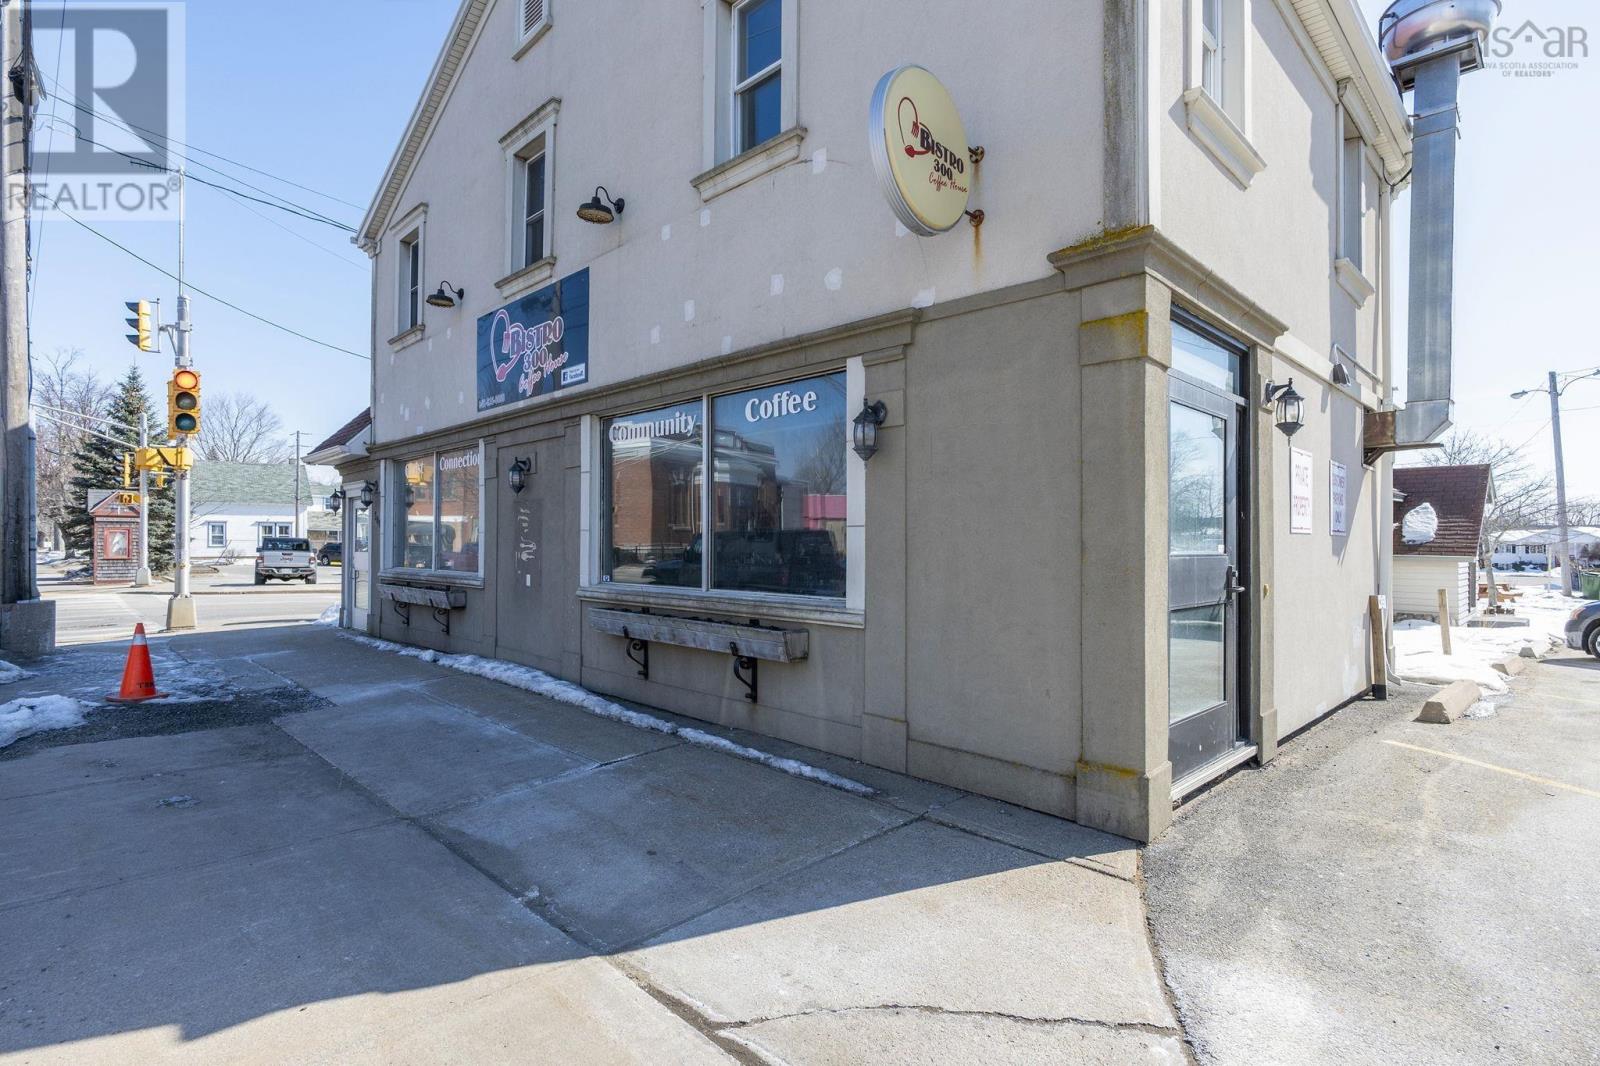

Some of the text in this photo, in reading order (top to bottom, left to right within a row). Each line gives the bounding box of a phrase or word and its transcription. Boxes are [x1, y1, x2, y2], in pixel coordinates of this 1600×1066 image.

[920, 123, 964, 174] BISTRO
[929, 171, 968, 193] Coffee House
[933, 158, 953, 181] 300
[509, 316, 565, 358] BISTRO
[523, 346, 549, 372] 300
[544, 351, 569, 378] House
[744, 391, 817, 423] Coffee
[609, 411, 697, 443] Community
